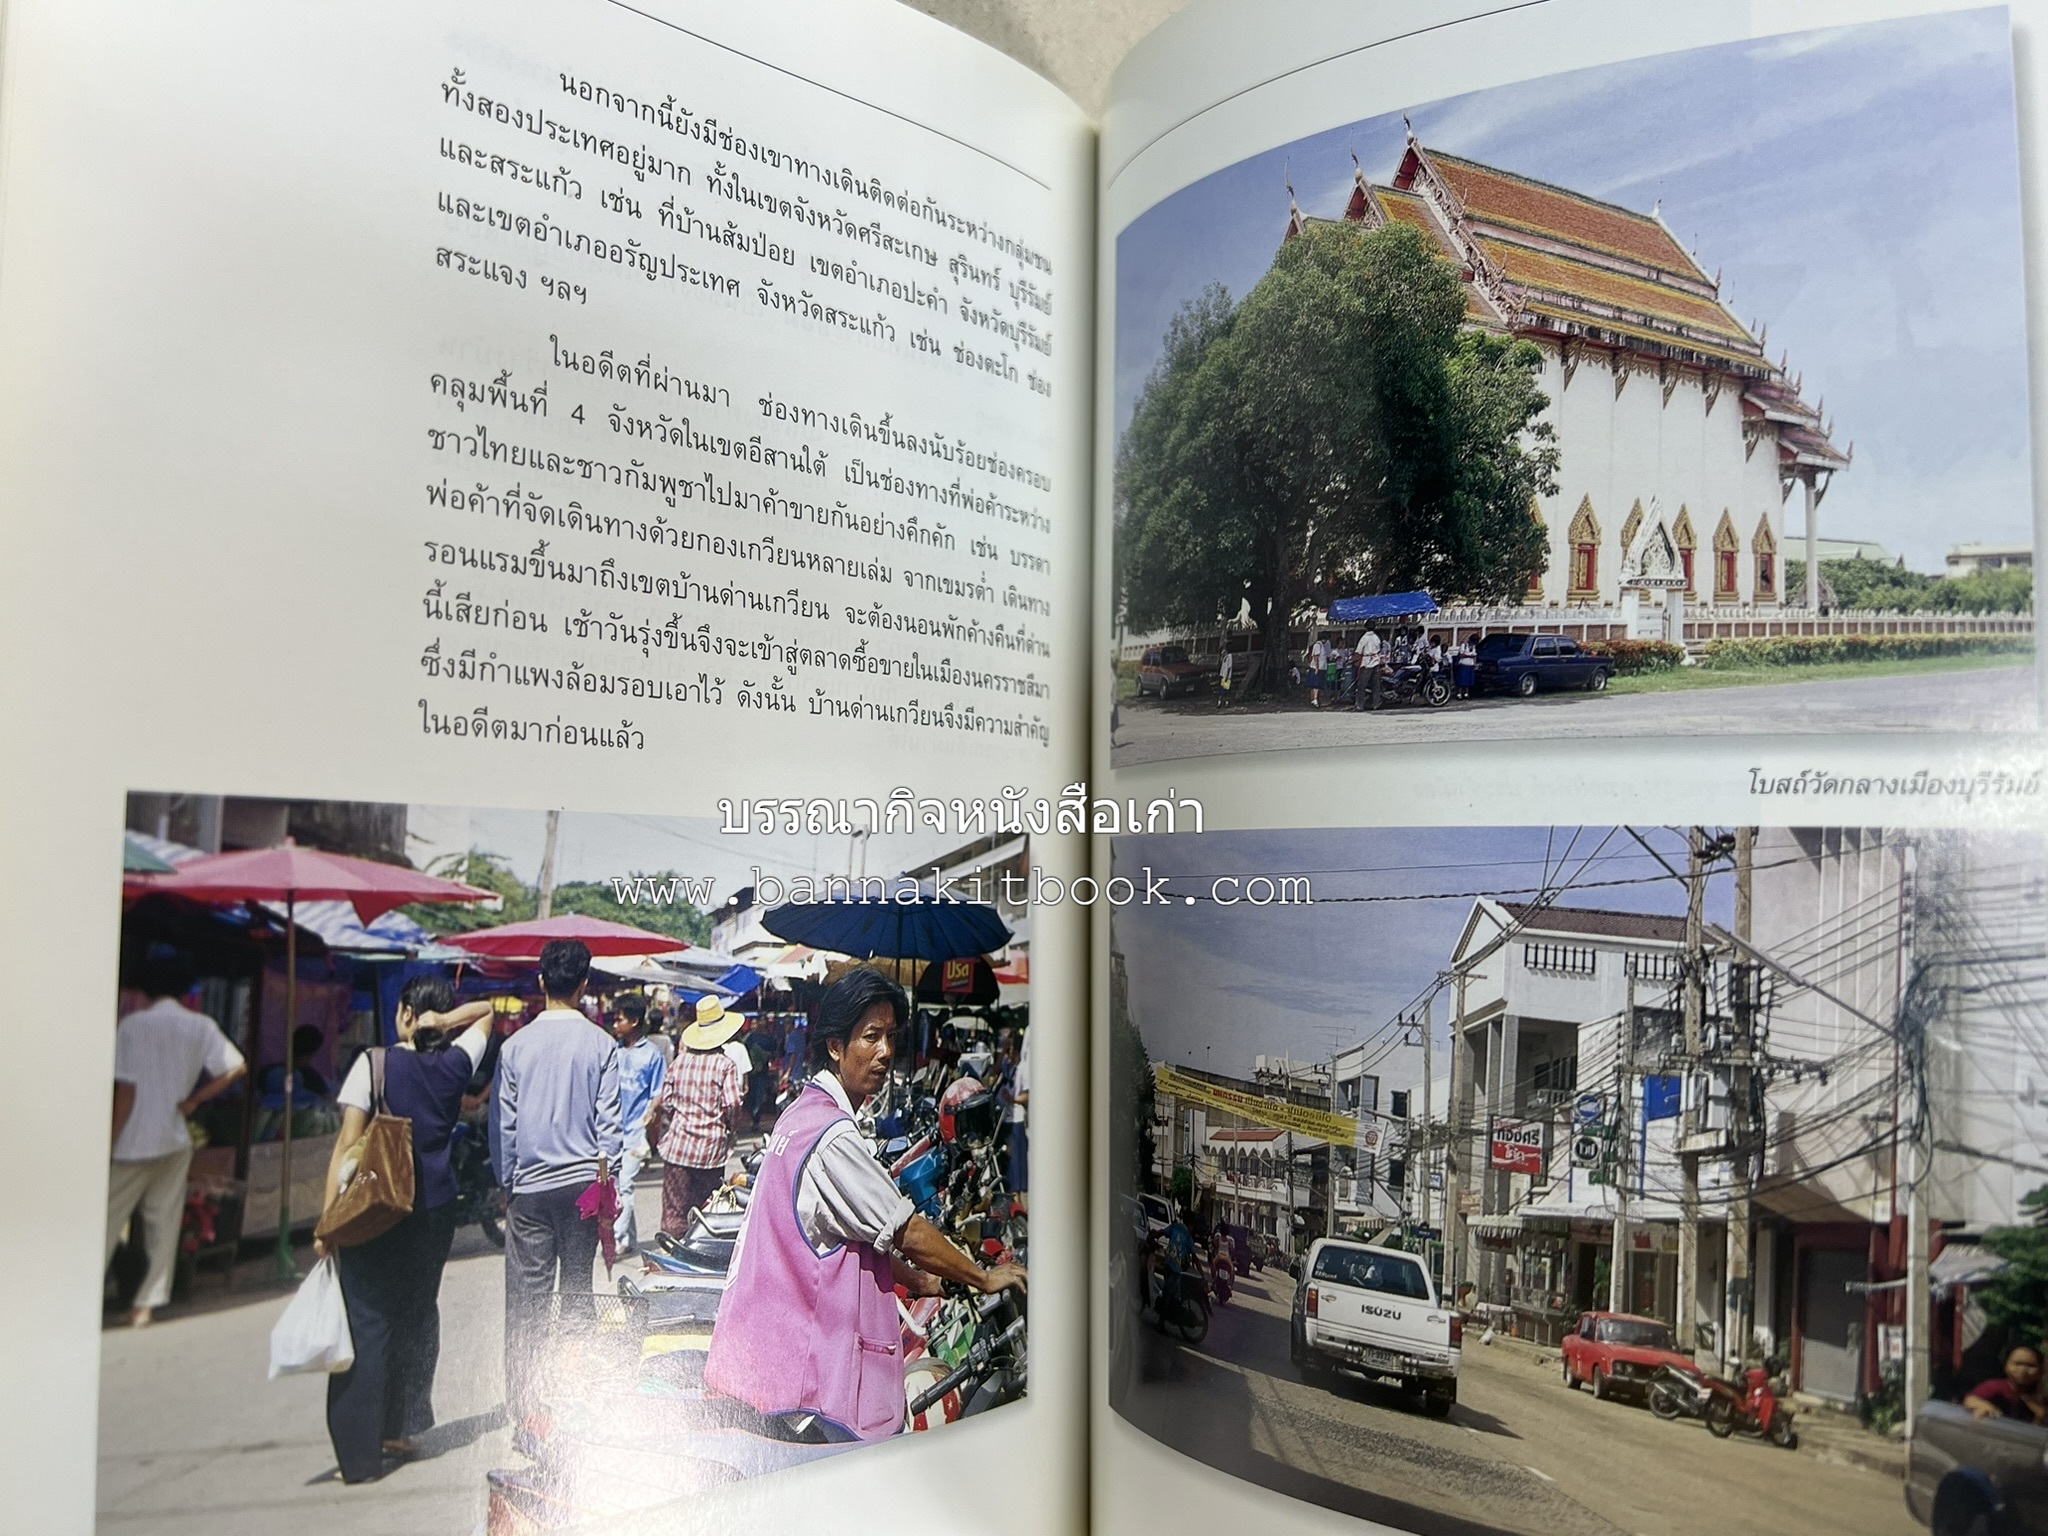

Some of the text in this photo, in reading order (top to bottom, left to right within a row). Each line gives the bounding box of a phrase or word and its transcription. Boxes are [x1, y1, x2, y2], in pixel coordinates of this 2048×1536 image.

[440, 137, 582, 200] และสระแก้ว
[600, 188, 642, 219] เช่น
[658, 196, 795, 266] ที่บ้านส้มป่อย
[810, 254, 948, 314] เขตอำเภอปะคำ
[442, 67, 691, 185] ทั้งสองประเทศอยู่มาก
[706, 161, 938, 267] ทั้งในเขตจังหวัดศรีสะเกษ
[949, 256, 1001, 291] สุรินทร์
[436, 247, 587, 305] สระแจง ฯลฯ
[438, 192, 1052, 397] และเขตอำเภออรัญประเทศ จังหวัดสระแก้ว เช่น ช่องตะโก ช่อง
[431, 369, 1051, 533] คลุมพื้นที่ 4 จังหวัดในเขตอีสานใต้ เป็นช่องทางที่พ่อค้าระหว่าง
[549, 334, 1051, 492] ในอดีตที่ผ่านมา ช่องทางเดินขึ้นลงนับร้อยช่องครอบ
[426, 478, 1051, 616] พ่อค้าที่จัดเดินทางด้วยกองเกวียนหลายเล่ม จากเขมรต่ำ เดินทาง
[427, 424, 1051, 575] ชาวไทยและชาวกัมพูชาไปมาค้าขายกันอย่างคึกคัก เช่น บรรดา
[423, 579, 1050, 699] นี้เสียก่อน เช้าวันรุ่งขึ้นจึงจะเข้าสู่ตลาดซื้อขายในเมืองนครราชสีมา
[424, 538, 1050, 658] รอนแรมขึ้นมาถึงเขตบ้านด่านเกวียน จะต้องนอนพักค้างคืนที่ด่าน
[419, 699, 645, 750] ในอดีตมาก่อนแล้ว
[421, 637, 1050, 748] ซึ่งมีกำแพงล้อมรอบเอาไว้ ดังนั้น บ้านด่านเกวียนจึงมีความสำคัญ
[1361, 1304, 1402, 1320] ISUZU
